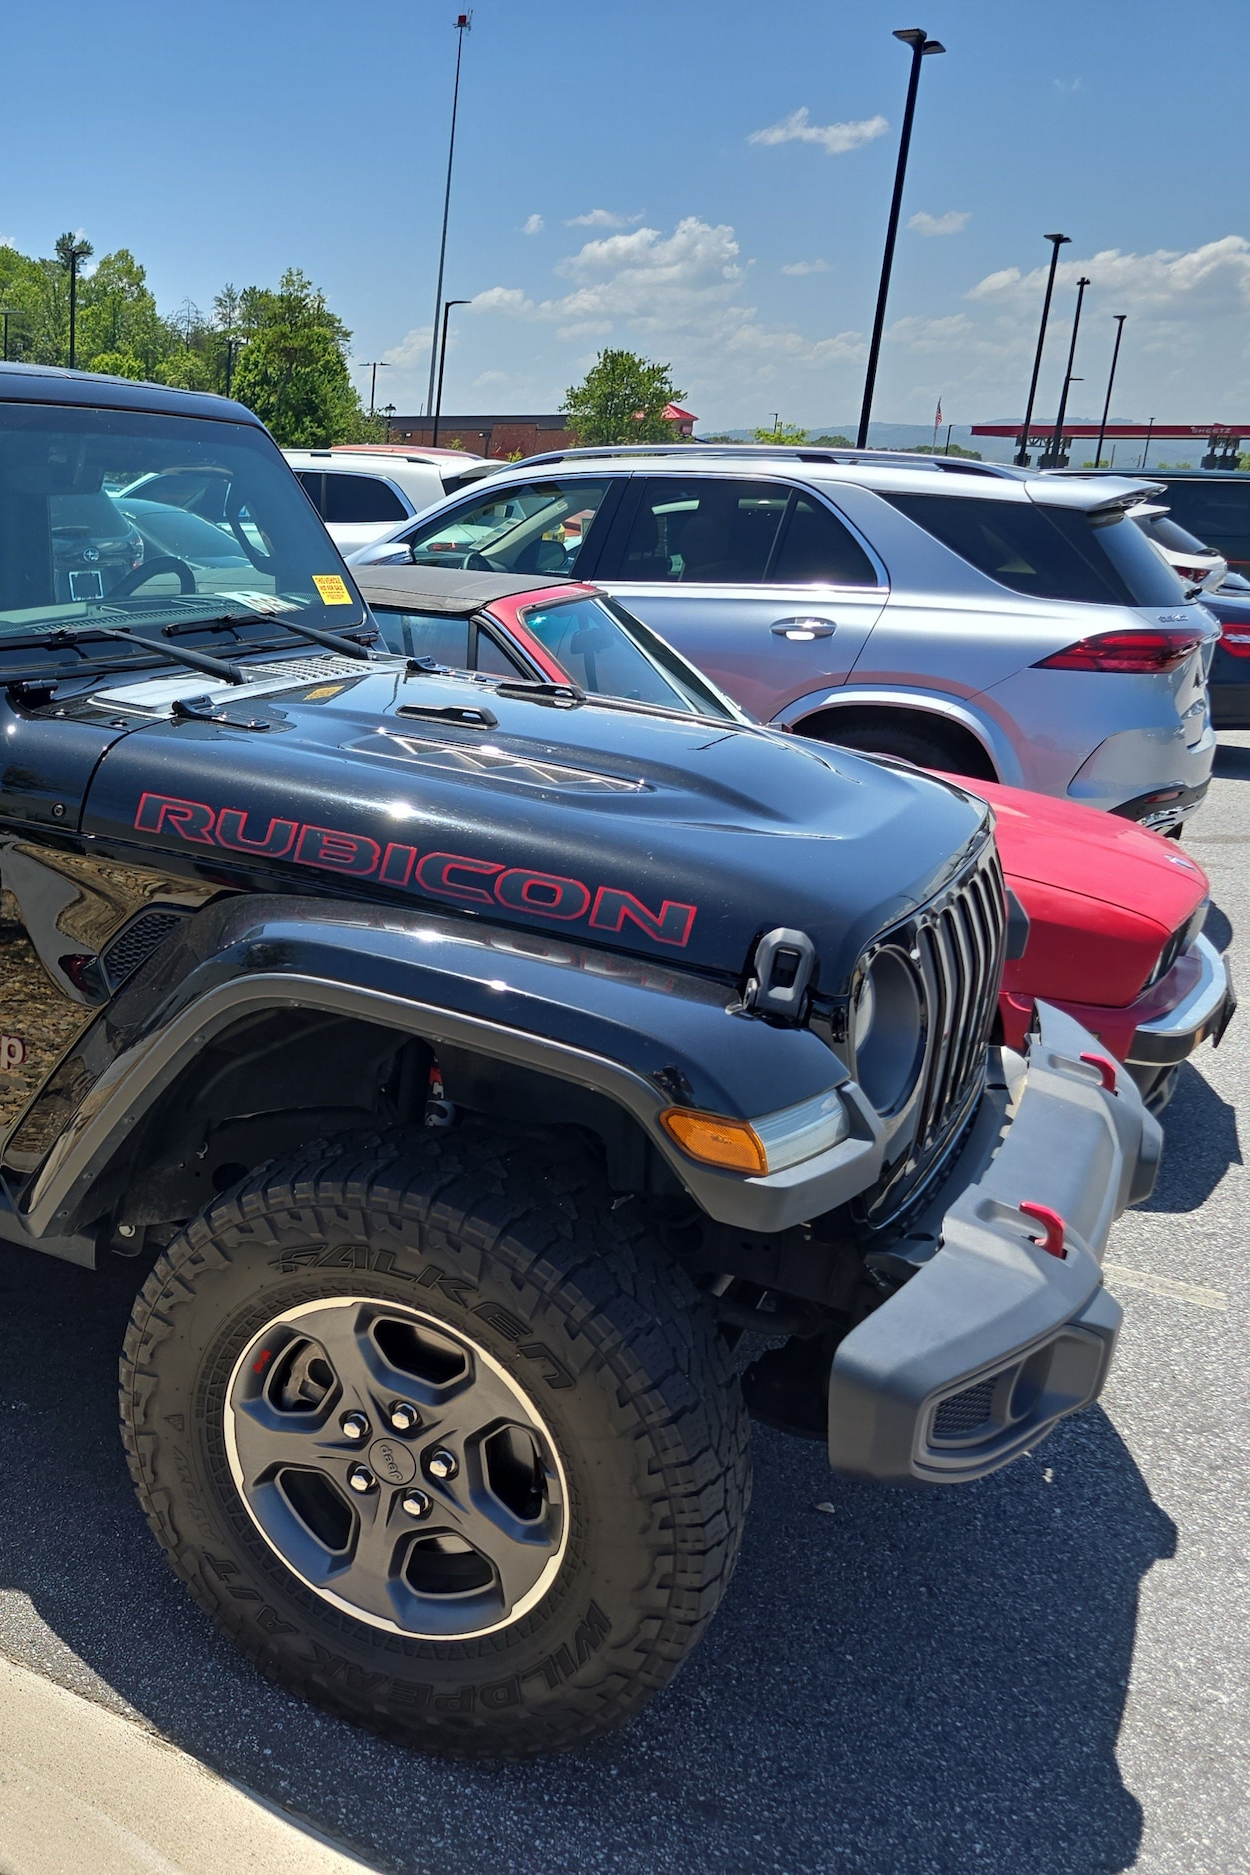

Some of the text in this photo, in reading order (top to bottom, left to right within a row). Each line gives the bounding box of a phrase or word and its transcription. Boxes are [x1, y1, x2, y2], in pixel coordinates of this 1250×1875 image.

[134, 792, 697, 948] RUBICON
[379, 1444, 403, 1481] Jeep
[202, 1552, 611, 1717] WILDPEAK A/T
